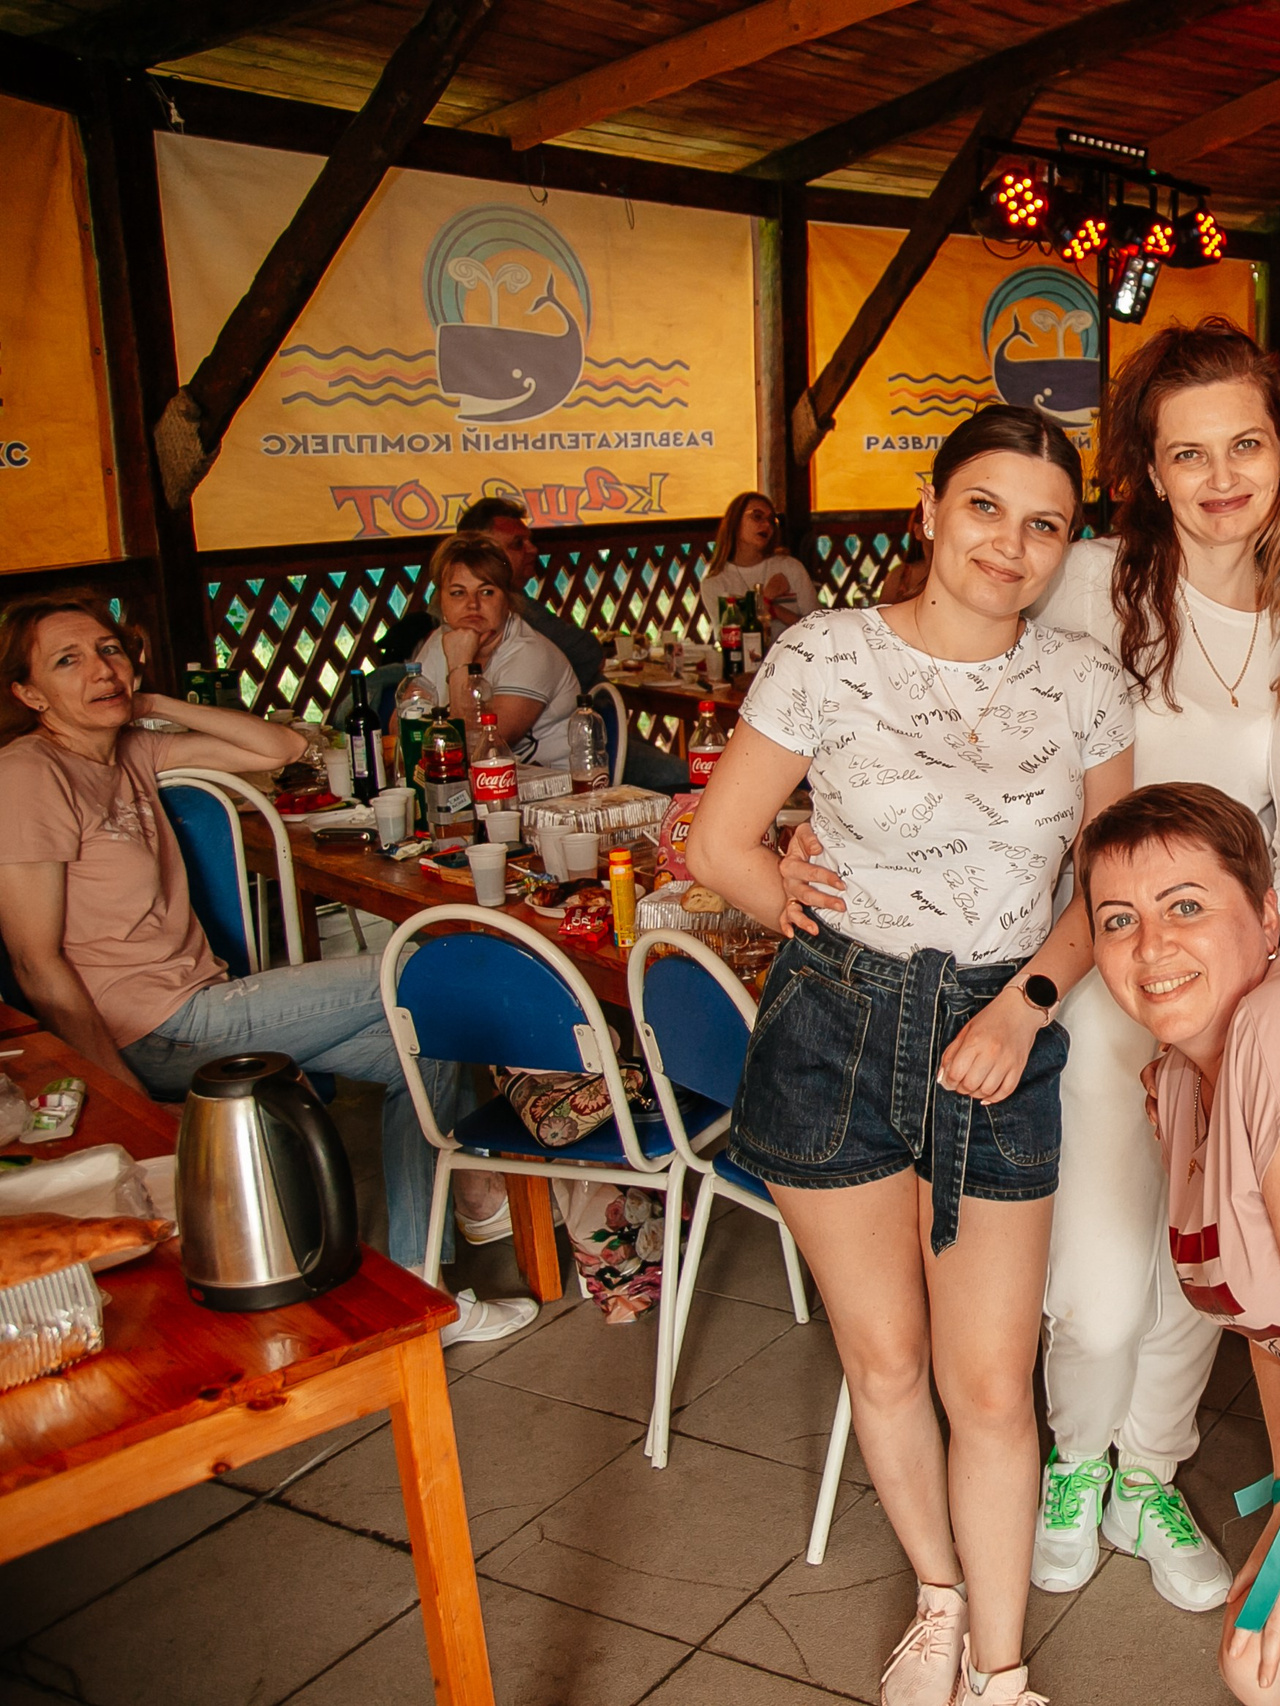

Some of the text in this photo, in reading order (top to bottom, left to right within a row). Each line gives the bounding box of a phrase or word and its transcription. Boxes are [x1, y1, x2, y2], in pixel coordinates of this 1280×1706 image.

[914, 750, 957, 769] Bonjour
[876, 768, 923, 785] Belle
[912, 792, 944, 823] Belle
[1002, 788, 1046, 805] Bonjour
[965, 793, 1009, 827] Amour
[910, 890, 948, 917] Bonjour
